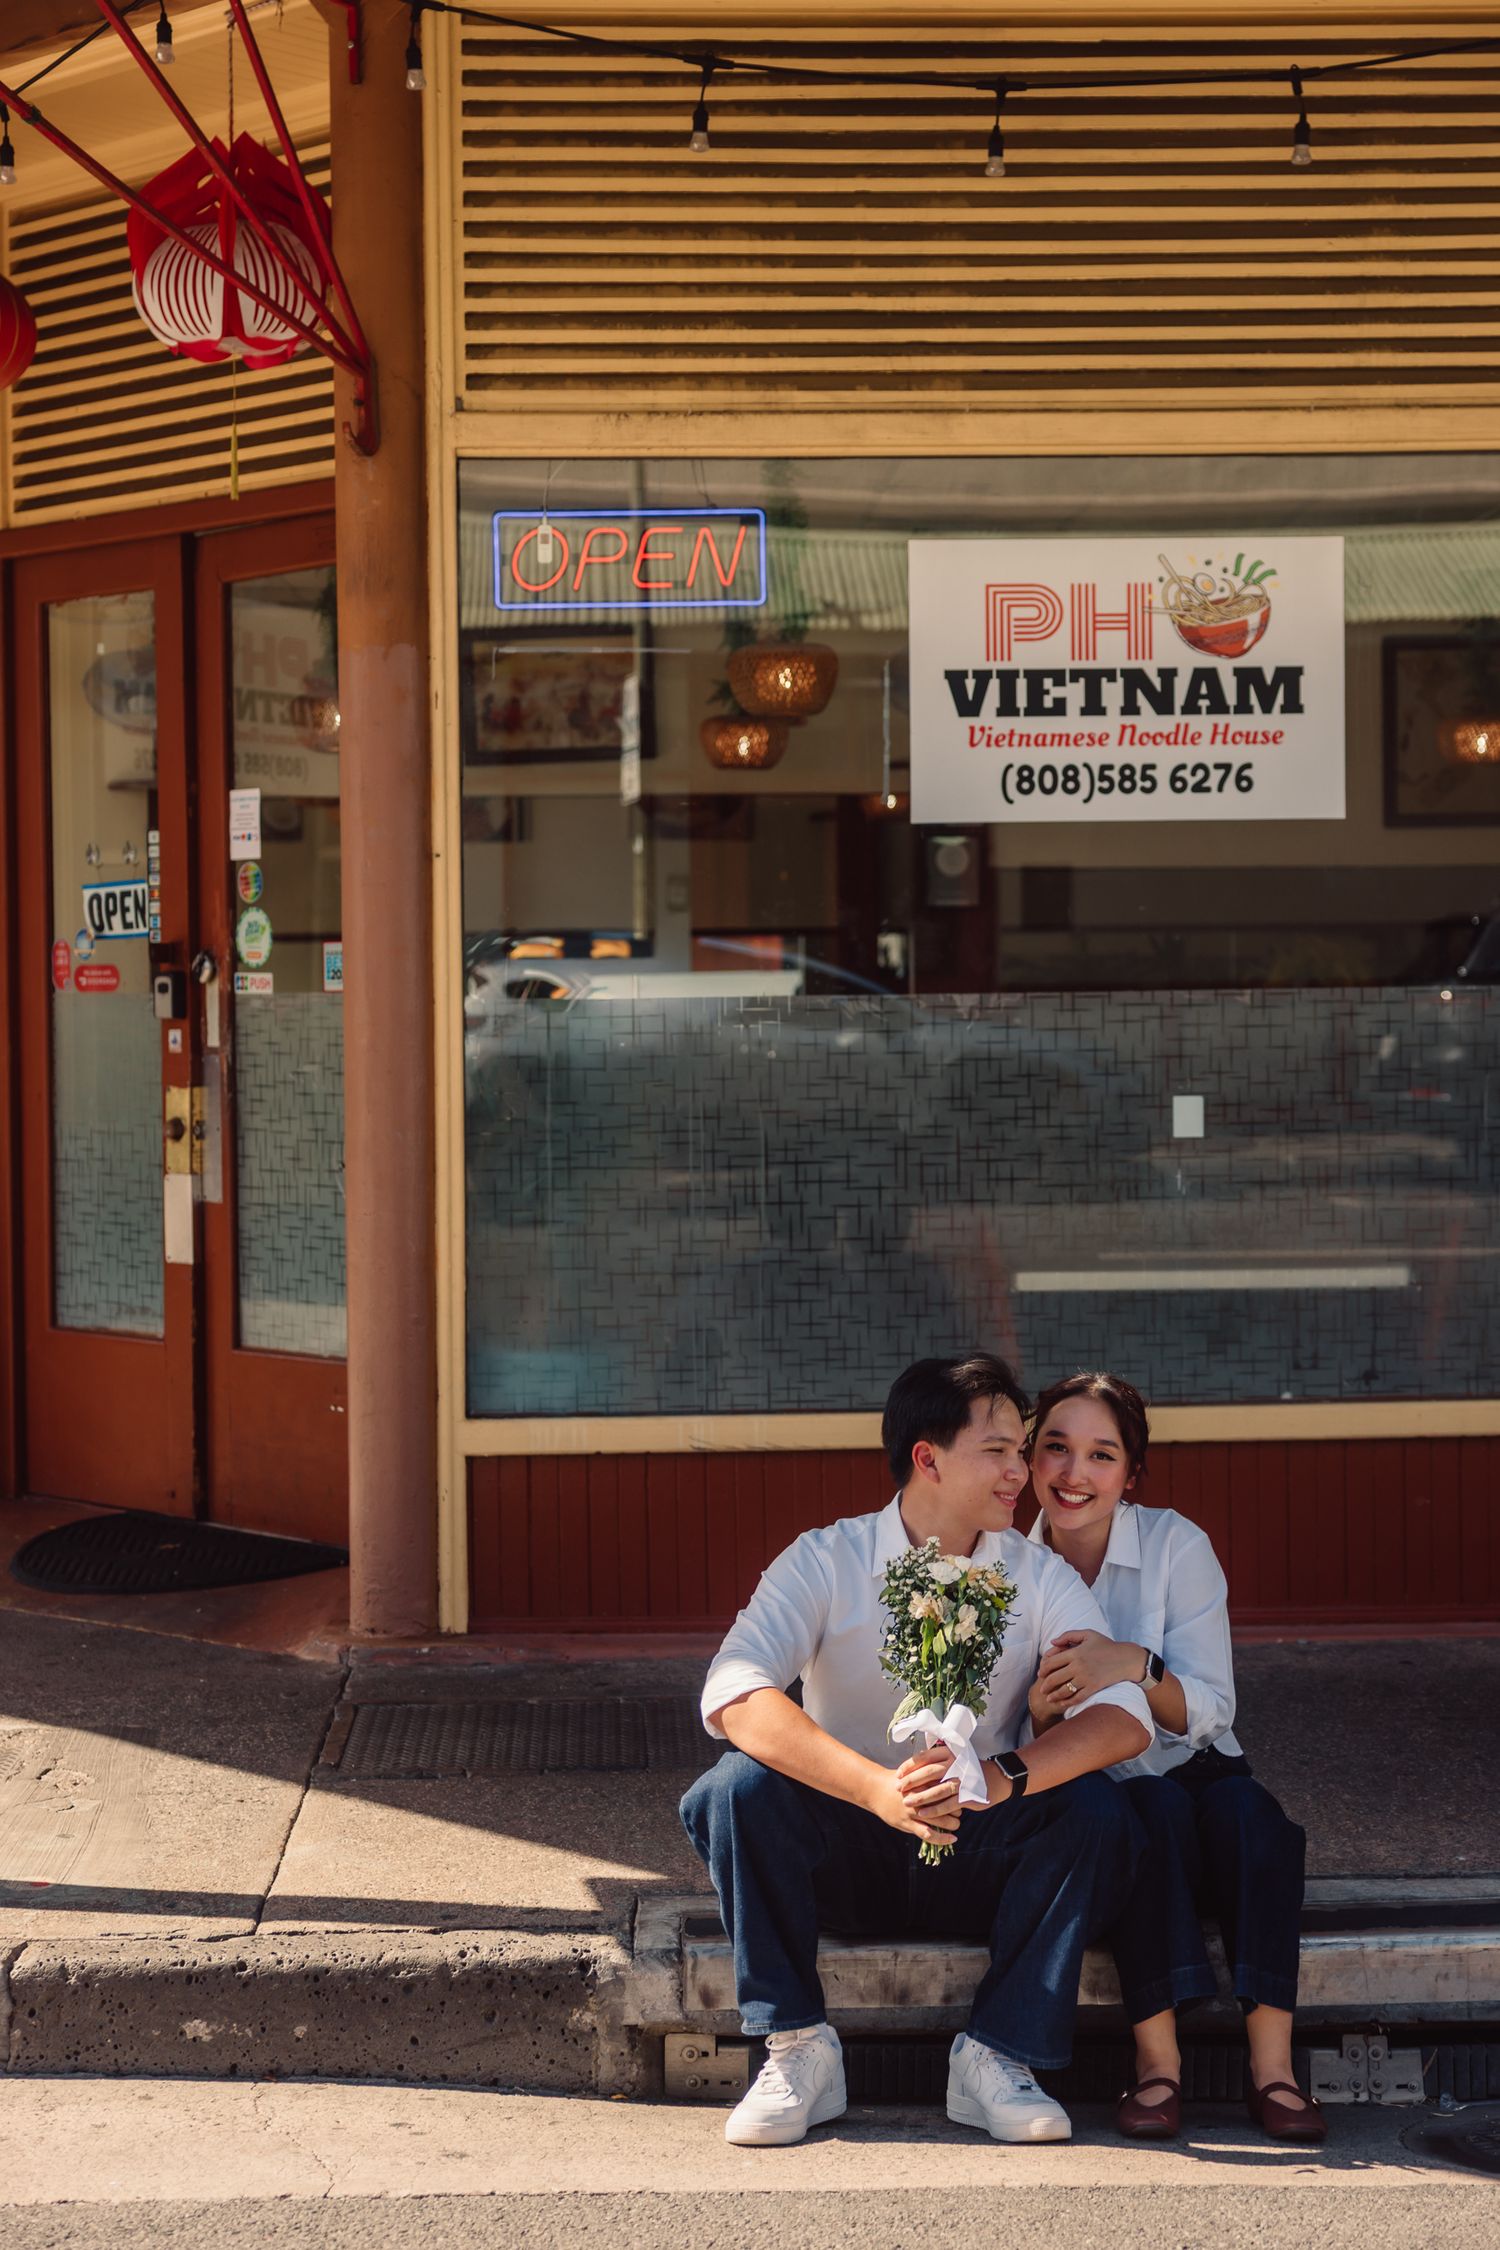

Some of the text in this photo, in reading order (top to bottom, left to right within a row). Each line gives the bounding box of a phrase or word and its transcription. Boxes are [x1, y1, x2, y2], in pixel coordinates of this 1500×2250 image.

[511, 524, 747, 592] OPEN
[943, 665, 1305, 718] VIETNAM
[967, 721, 1285, 748] Vietnamese Noodle House
[1001, 762, 1255, 804] (808)585 6276
[88, 888, 148, 932] OPEN
[250, 975, 271, 989] PUSH
